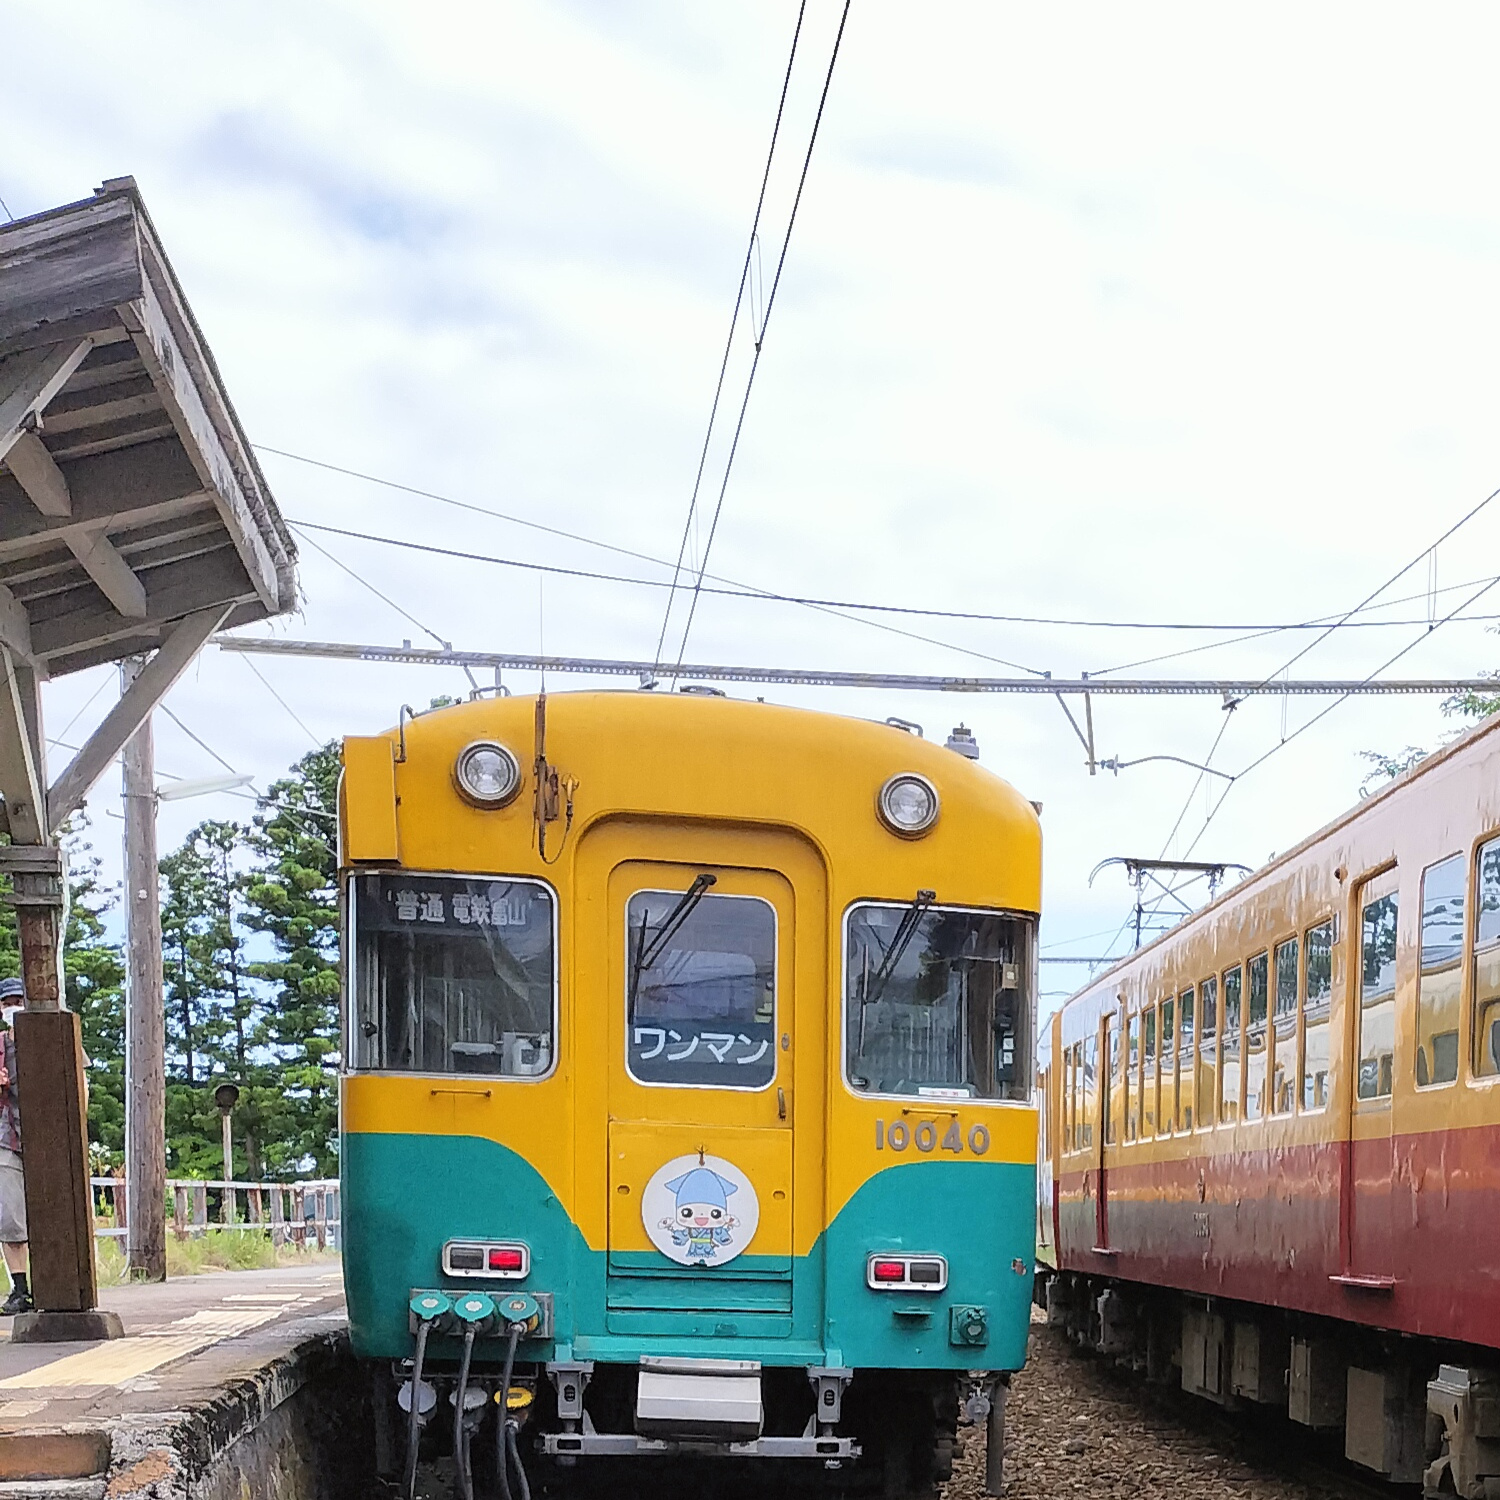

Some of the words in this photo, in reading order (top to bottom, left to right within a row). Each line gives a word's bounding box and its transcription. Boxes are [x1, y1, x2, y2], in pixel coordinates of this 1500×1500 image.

[395, 889, 446, 923] 普通
[452, 893, 527, 926] 電鉄富山
[633, 1027, 769, 1064] ワンマン
[875, 1118, 991, 1156] 10040
